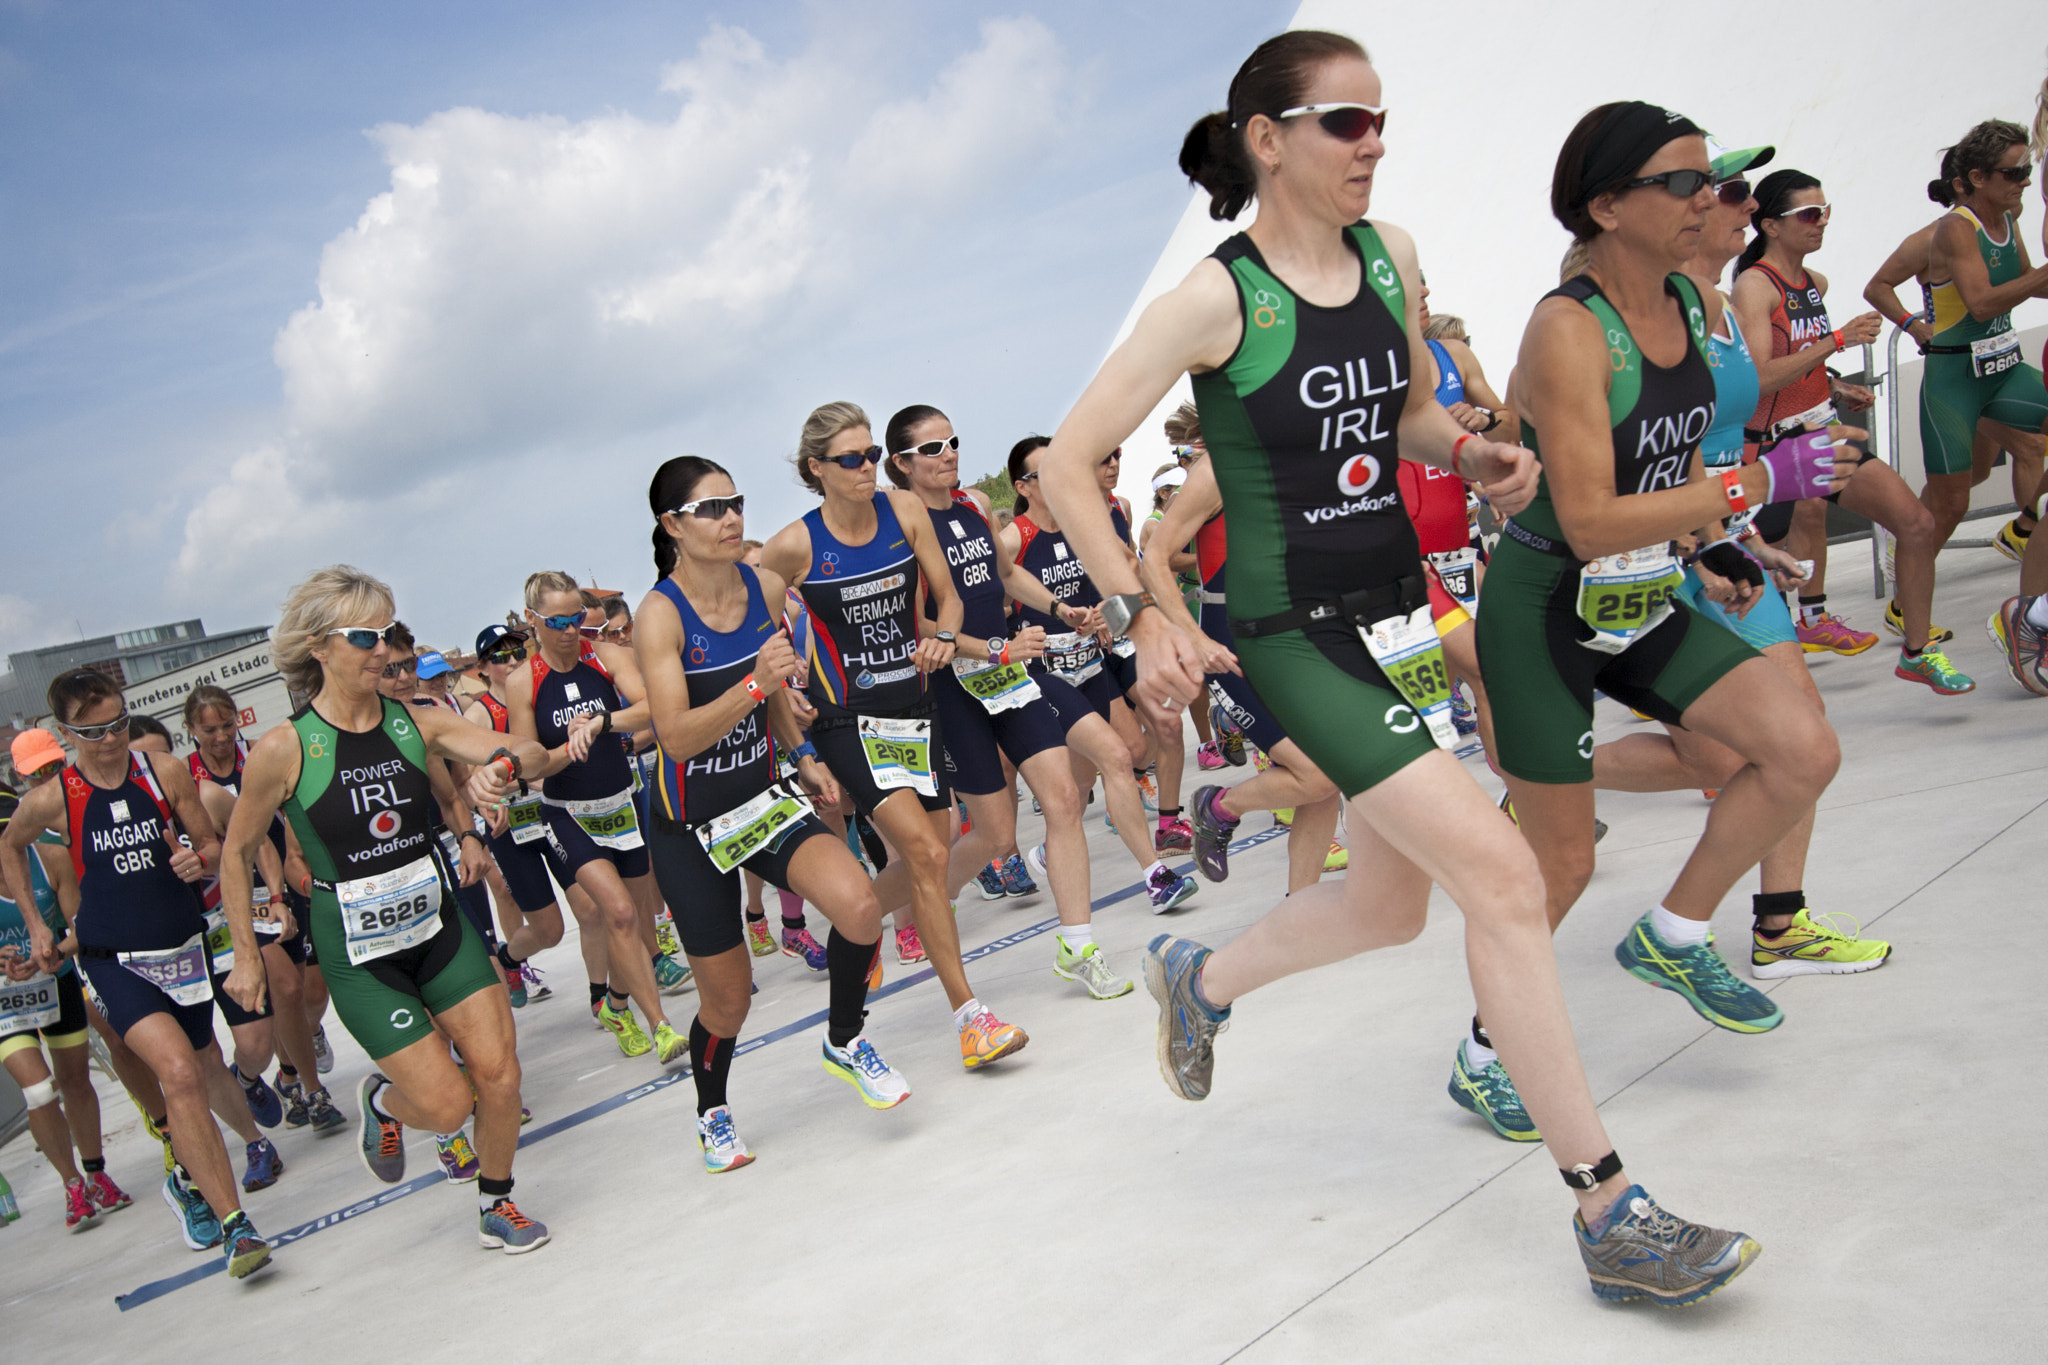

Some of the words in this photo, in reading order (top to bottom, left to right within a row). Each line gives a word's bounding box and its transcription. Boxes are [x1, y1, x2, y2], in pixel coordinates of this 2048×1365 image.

[1299, 348, 1410, 410] GILL
[1985, 351, 2020, 376] 2603
[1319, 402, 1390, 451] IRL
[1637, 450, 1689, 495] IRL
[1303, 492, 1398, 524] vodafone
[947, 536, 993, 567] CLARKE
[840, 573, 906, 601] BREAKWOOD
[963, 562, 991, 587] GBR
[1042, 558, 1089, 586] BURGES
[1053, 580, 1081, 600] GBR
[842, 591, 907, 625] VERMAAK
[861, 617, 904, 647] RSA
[843, 639, 919, 668] HUUB
[1053, 649, 1096, 669] 2590
[122, 682, 191, 712] arreteras
[195, 671, 217, 687] del
[220, 654, 270, 679] Estado
[716, 714, 758, 751] RSA
[686, 736, 768, 776] HUUB
[875, 743, 918, 766] 2572
[340, 759, 407, 785] POWER
[350, 780, 412, 815] IRL
[91, 818, 160, 852] HAGGART
[347, 832, 425, 864] vodafone
[725, 811, 788, 862] 2573
[113, 848, 156, 875] GBR
[359, 894, 428, 931] 2626
